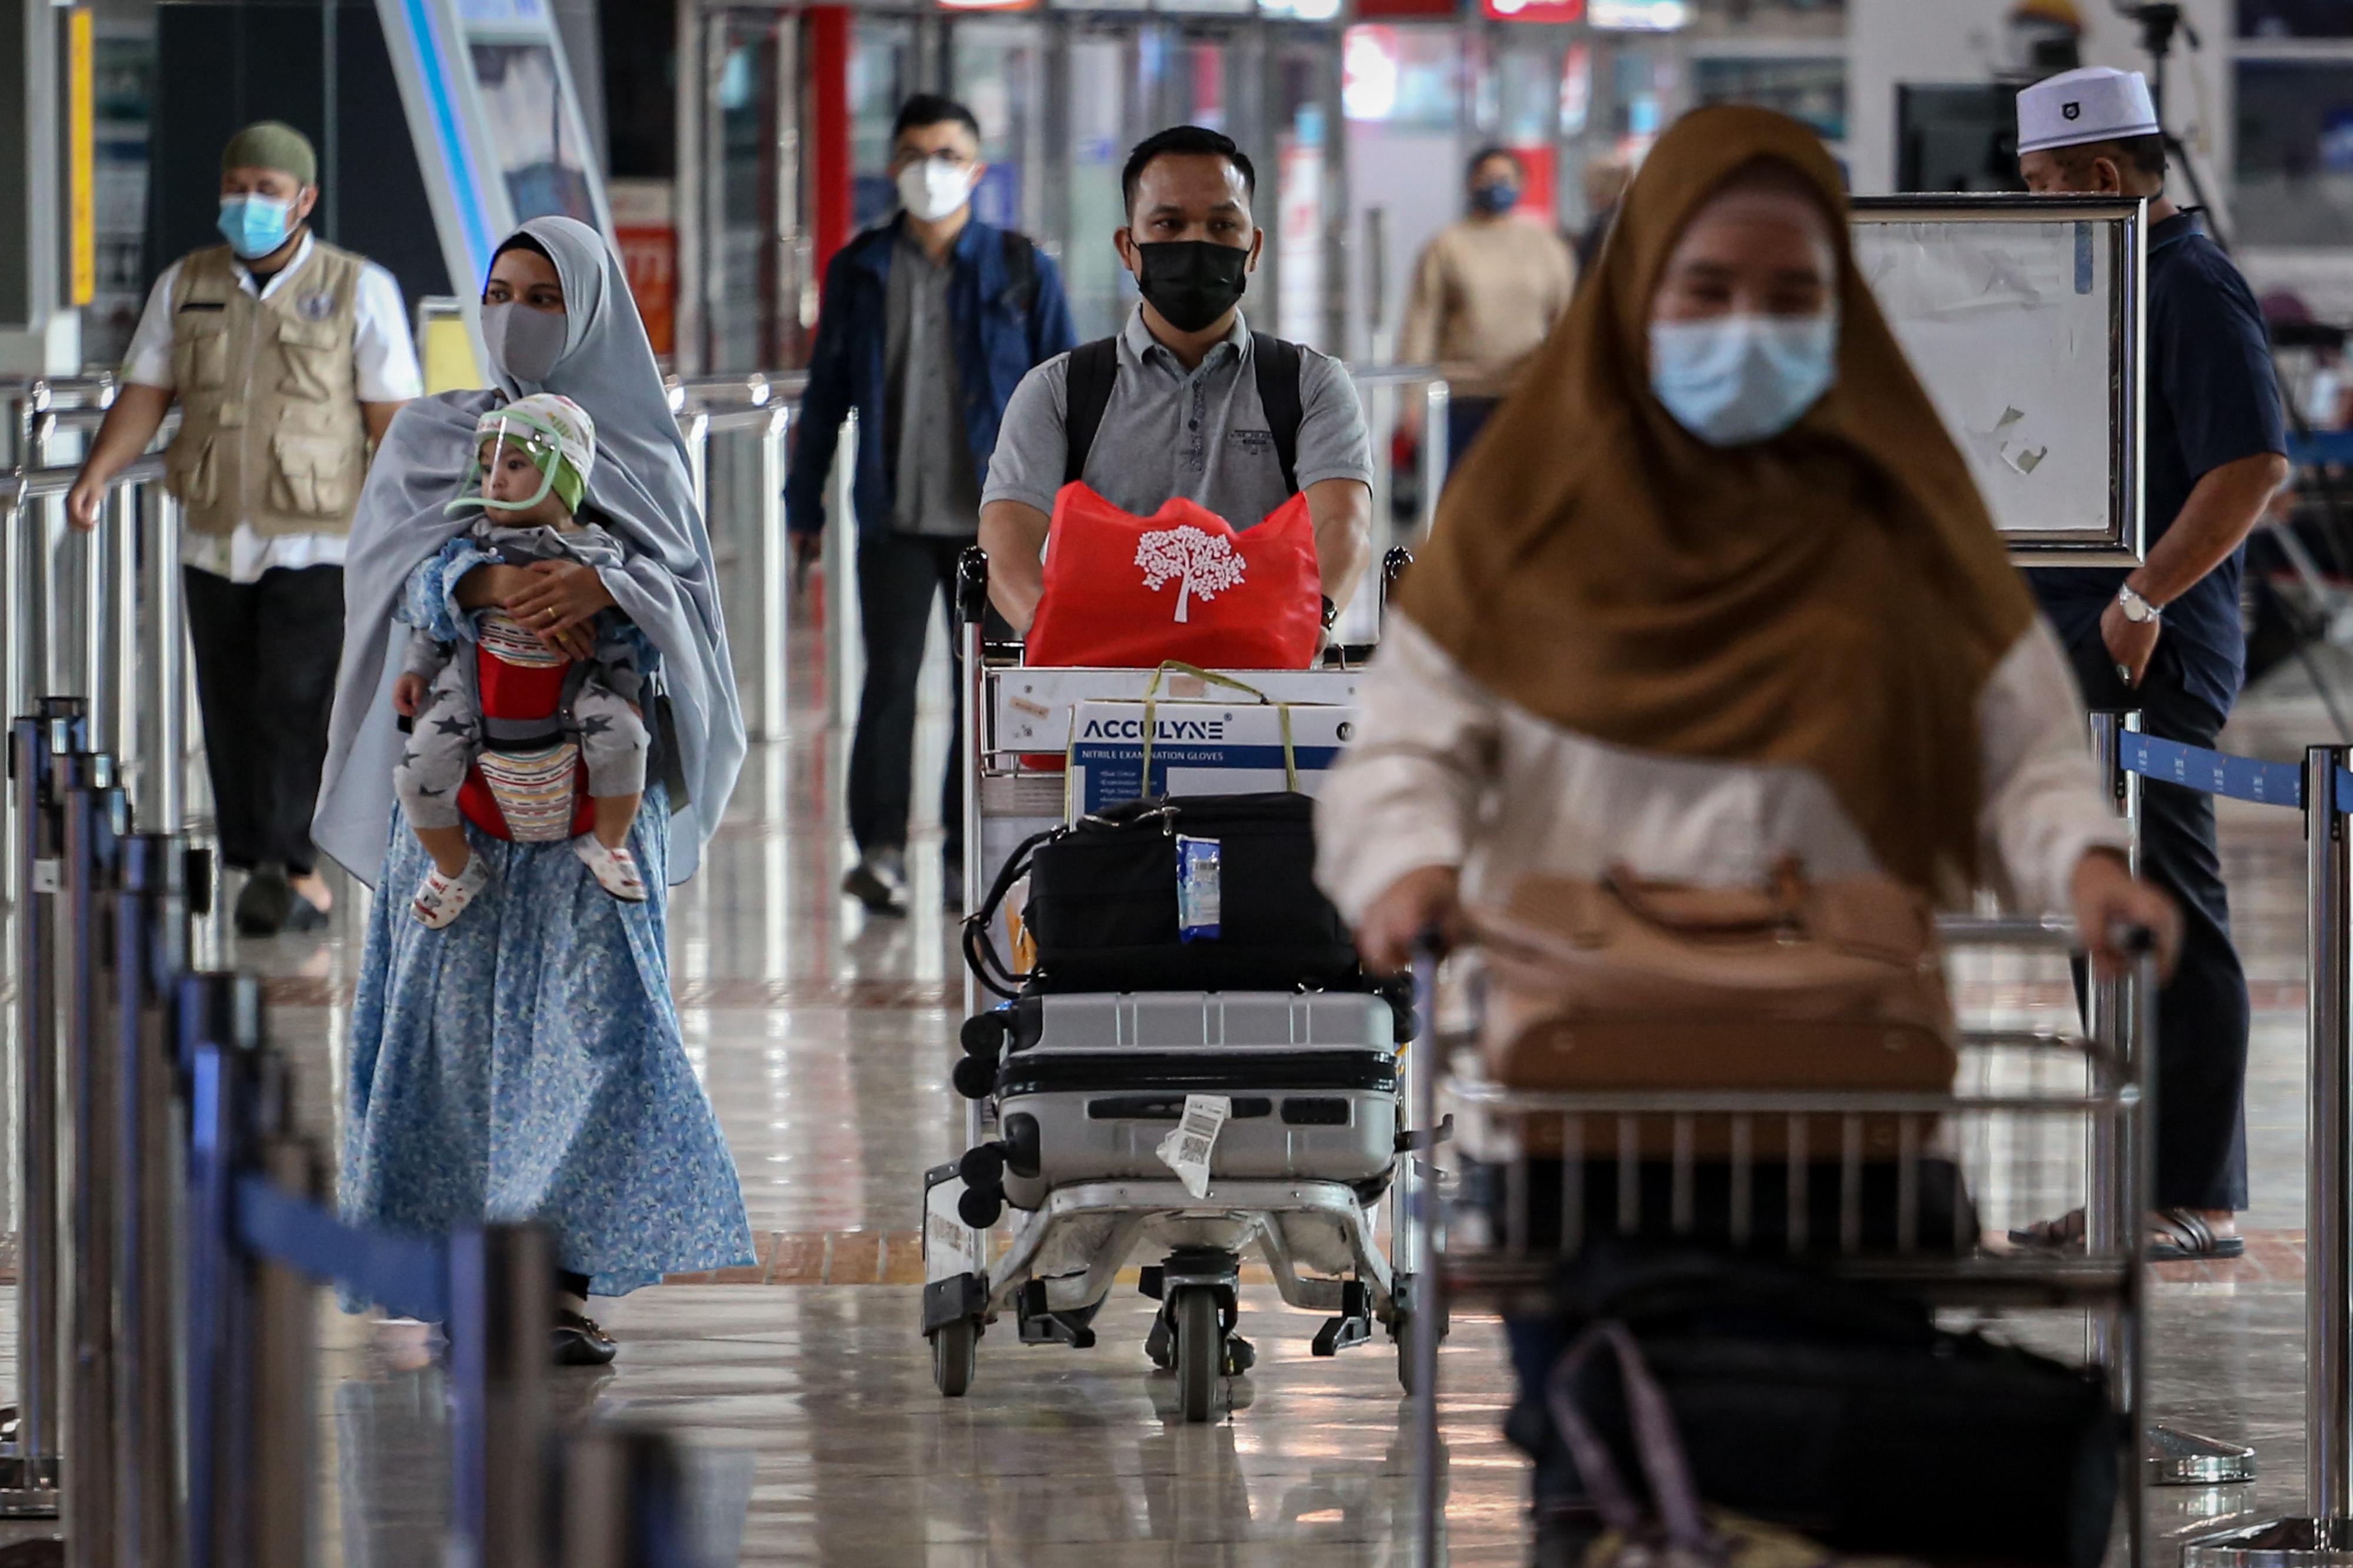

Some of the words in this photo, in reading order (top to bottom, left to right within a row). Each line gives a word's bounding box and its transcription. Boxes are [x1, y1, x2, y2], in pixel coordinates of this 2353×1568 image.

[1082, 750, 1116, 759] NITRILE
[1119, 750, 1185, 760] EXAMNATION
[1187, 751, 1224, 761] GLOVES
